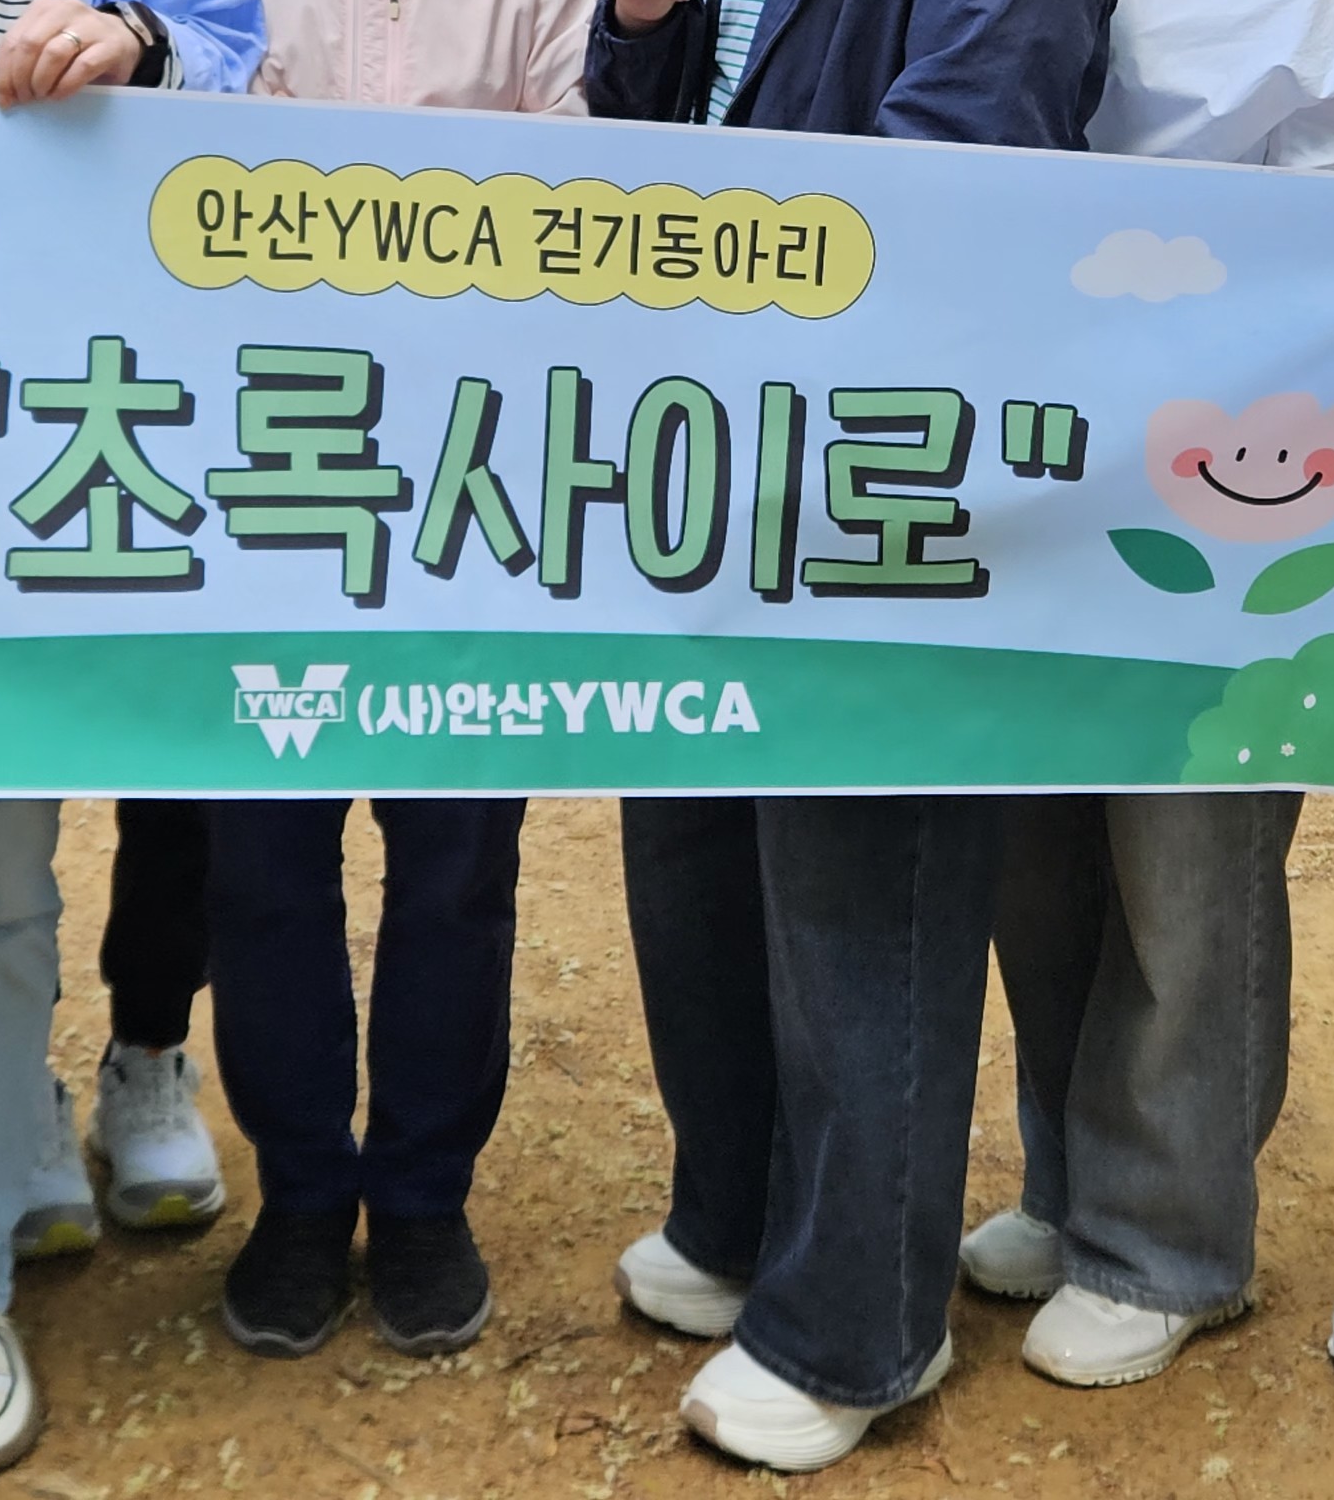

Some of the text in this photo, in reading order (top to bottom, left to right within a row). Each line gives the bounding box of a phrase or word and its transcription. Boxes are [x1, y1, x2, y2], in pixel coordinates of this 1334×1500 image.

[197, 188, 827, 286] 안산YWCA 걷기동아리
[243, 691, 339, 718] YWCA
[357, 680, 761, 736] (사)안산YWCA
